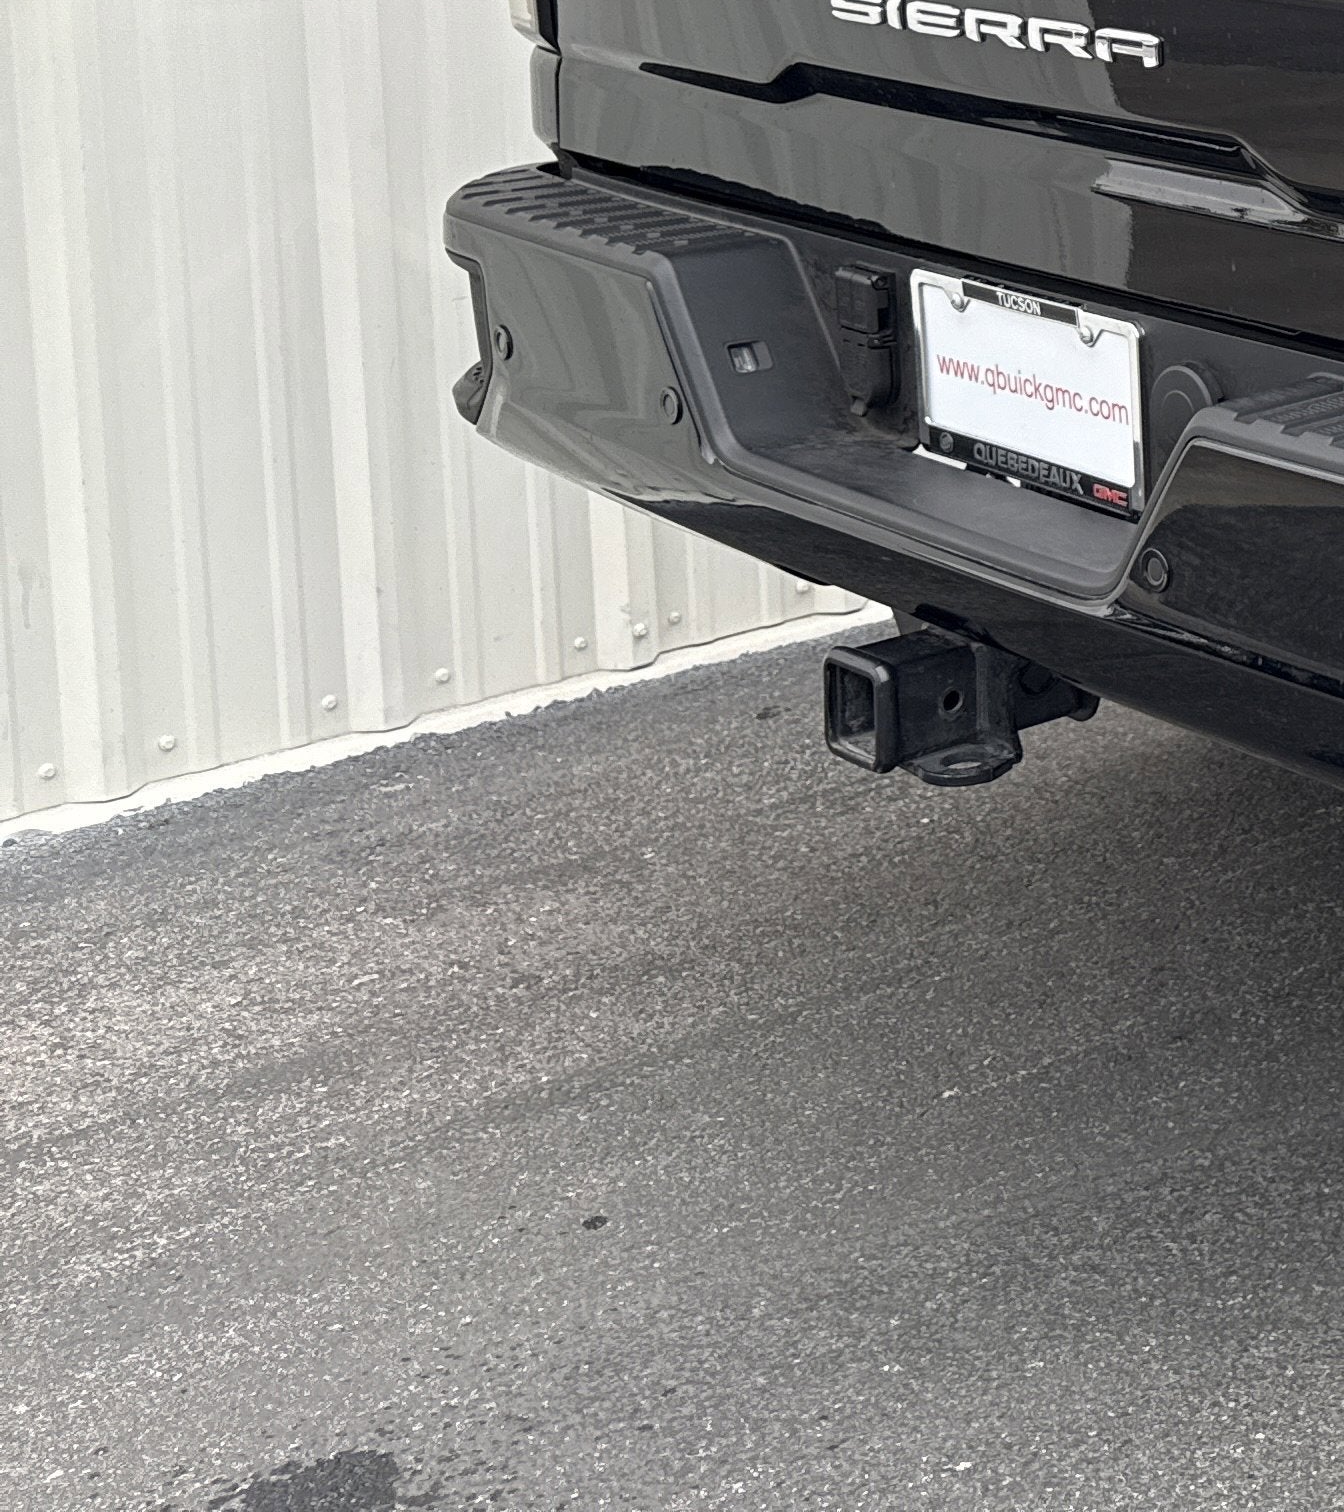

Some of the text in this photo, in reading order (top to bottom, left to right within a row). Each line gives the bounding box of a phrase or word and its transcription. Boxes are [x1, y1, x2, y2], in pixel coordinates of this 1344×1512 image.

[996, 291, 1041, 316] TUCSON
[936, 353, 1130, 426] www.qbuickgmc.com
[973, 442, 1128, 507] QUEBEDEAUX GMC
